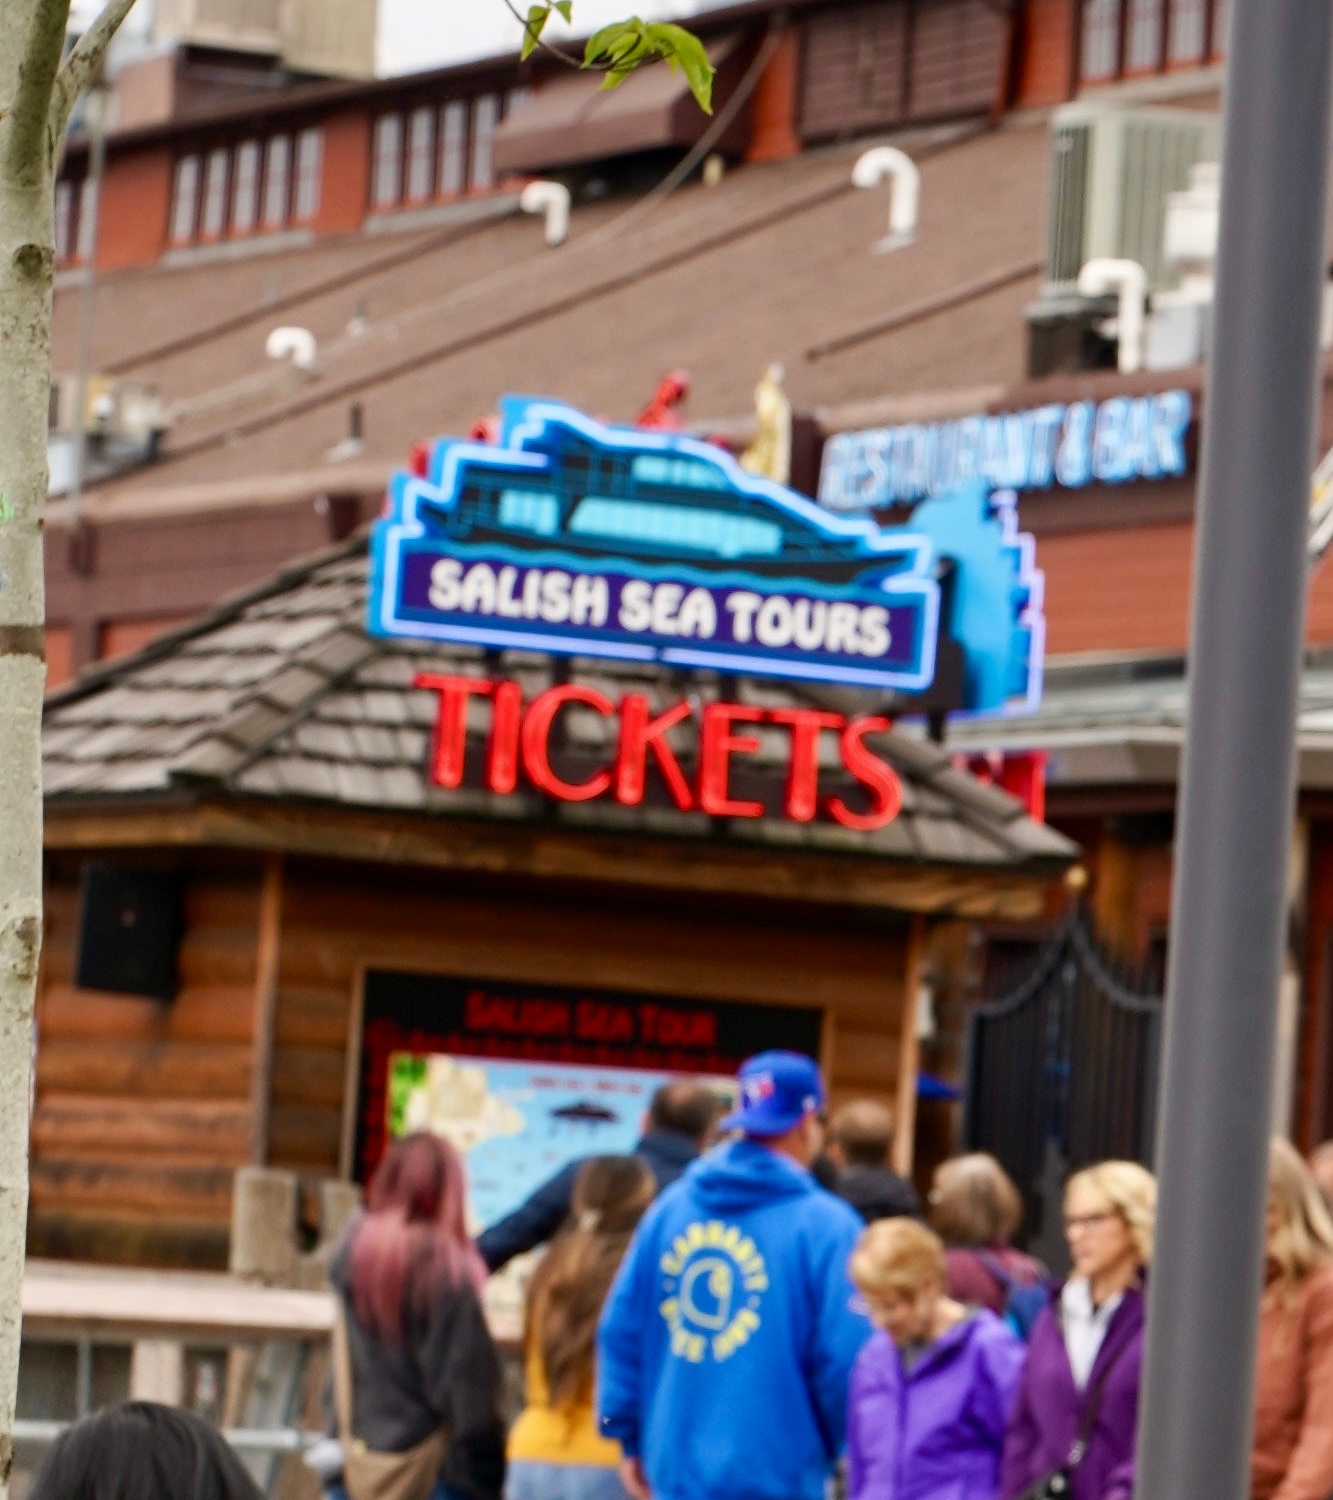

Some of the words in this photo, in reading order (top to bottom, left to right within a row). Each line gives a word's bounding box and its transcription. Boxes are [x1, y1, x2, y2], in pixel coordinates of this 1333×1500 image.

[428, 557, 610, 628] SALISH
[618, 579, 718, 640] SEA
[725, 590, 893, 658] TOURS
[413, 672, 903, 832] TICKETS
